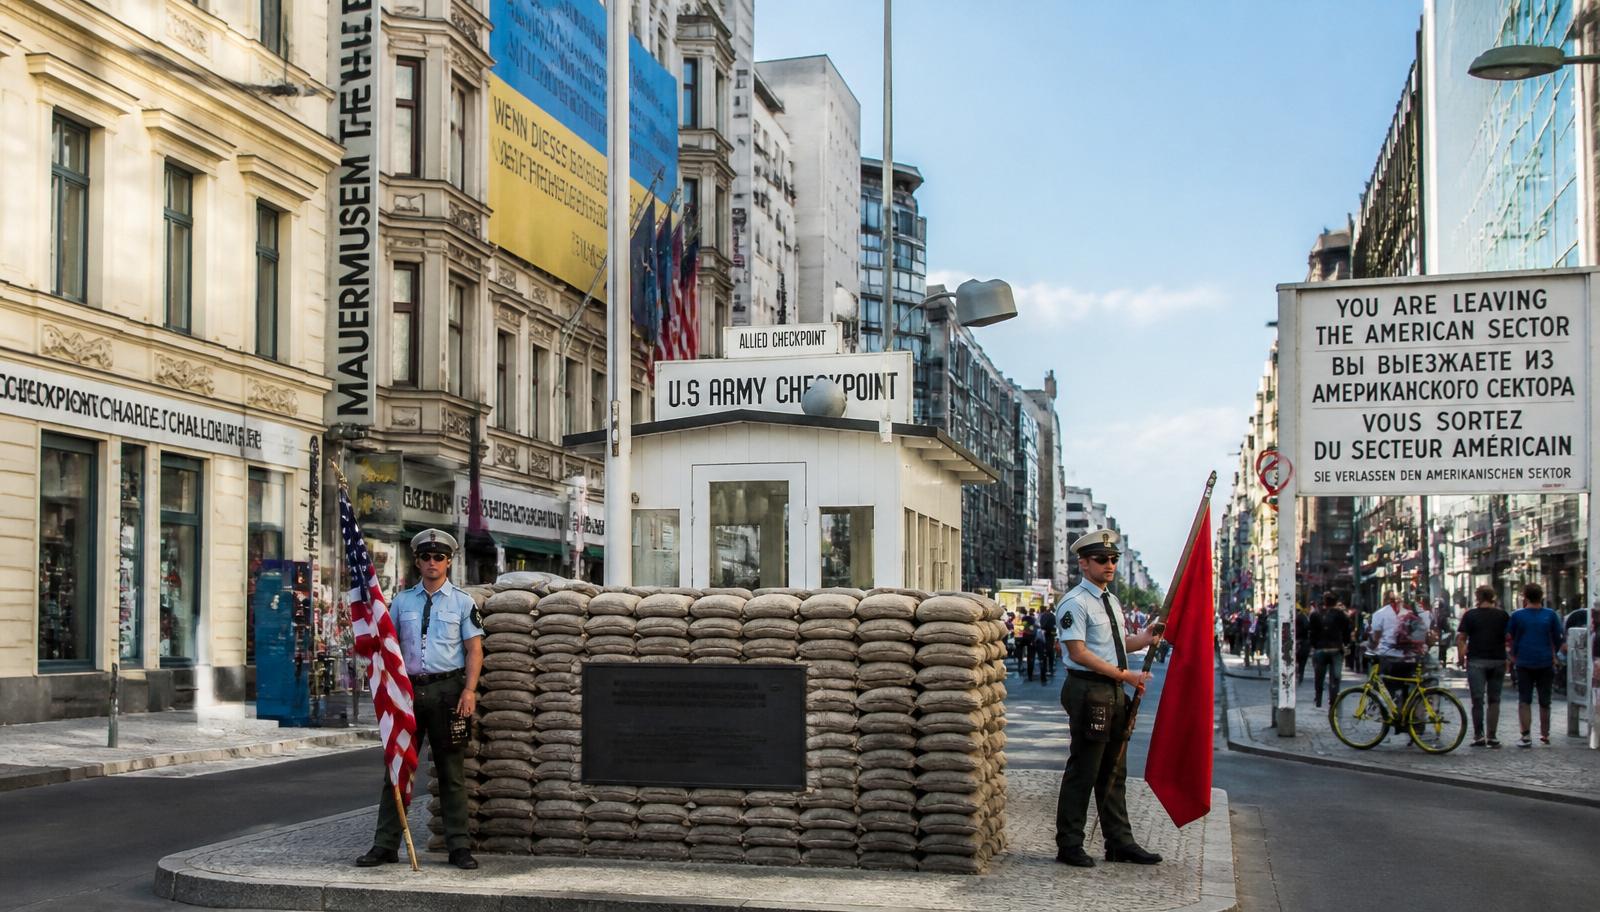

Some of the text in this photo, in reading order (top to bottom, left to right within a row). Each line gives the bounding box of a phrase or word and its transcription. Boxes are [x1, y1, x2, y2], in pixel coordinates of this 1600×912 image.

[493, 96, 528, 142] WENN
[337, 155, 370, 416] MAUERMUSEM
[1336, 289, 1547, 318] YOU ARE LEAVING
[739, 330, 826, 349] ALLIED CHECKPOINT
[1316, 316, 1569, 345] THE AMERICAN SECTOR
[1332, 349, 1553, 376] ВЫ ВЫЕЗЖАЕТЕ ИЗ
[709, 377, 767, 406] ARMY
[1312, 376, 1575, 403] АМЕРИКАНСКОГО СЕКТОРА
[1363, 410, 1523, 433] VOUS SORTEZ
[1314, 434, 1572, 461] DU SECTEUR AMÉRICAIN
[1314, 467, 1572, 482] SIE VERLASSEN DEN AMERIKANISCHEN SEKTOR
